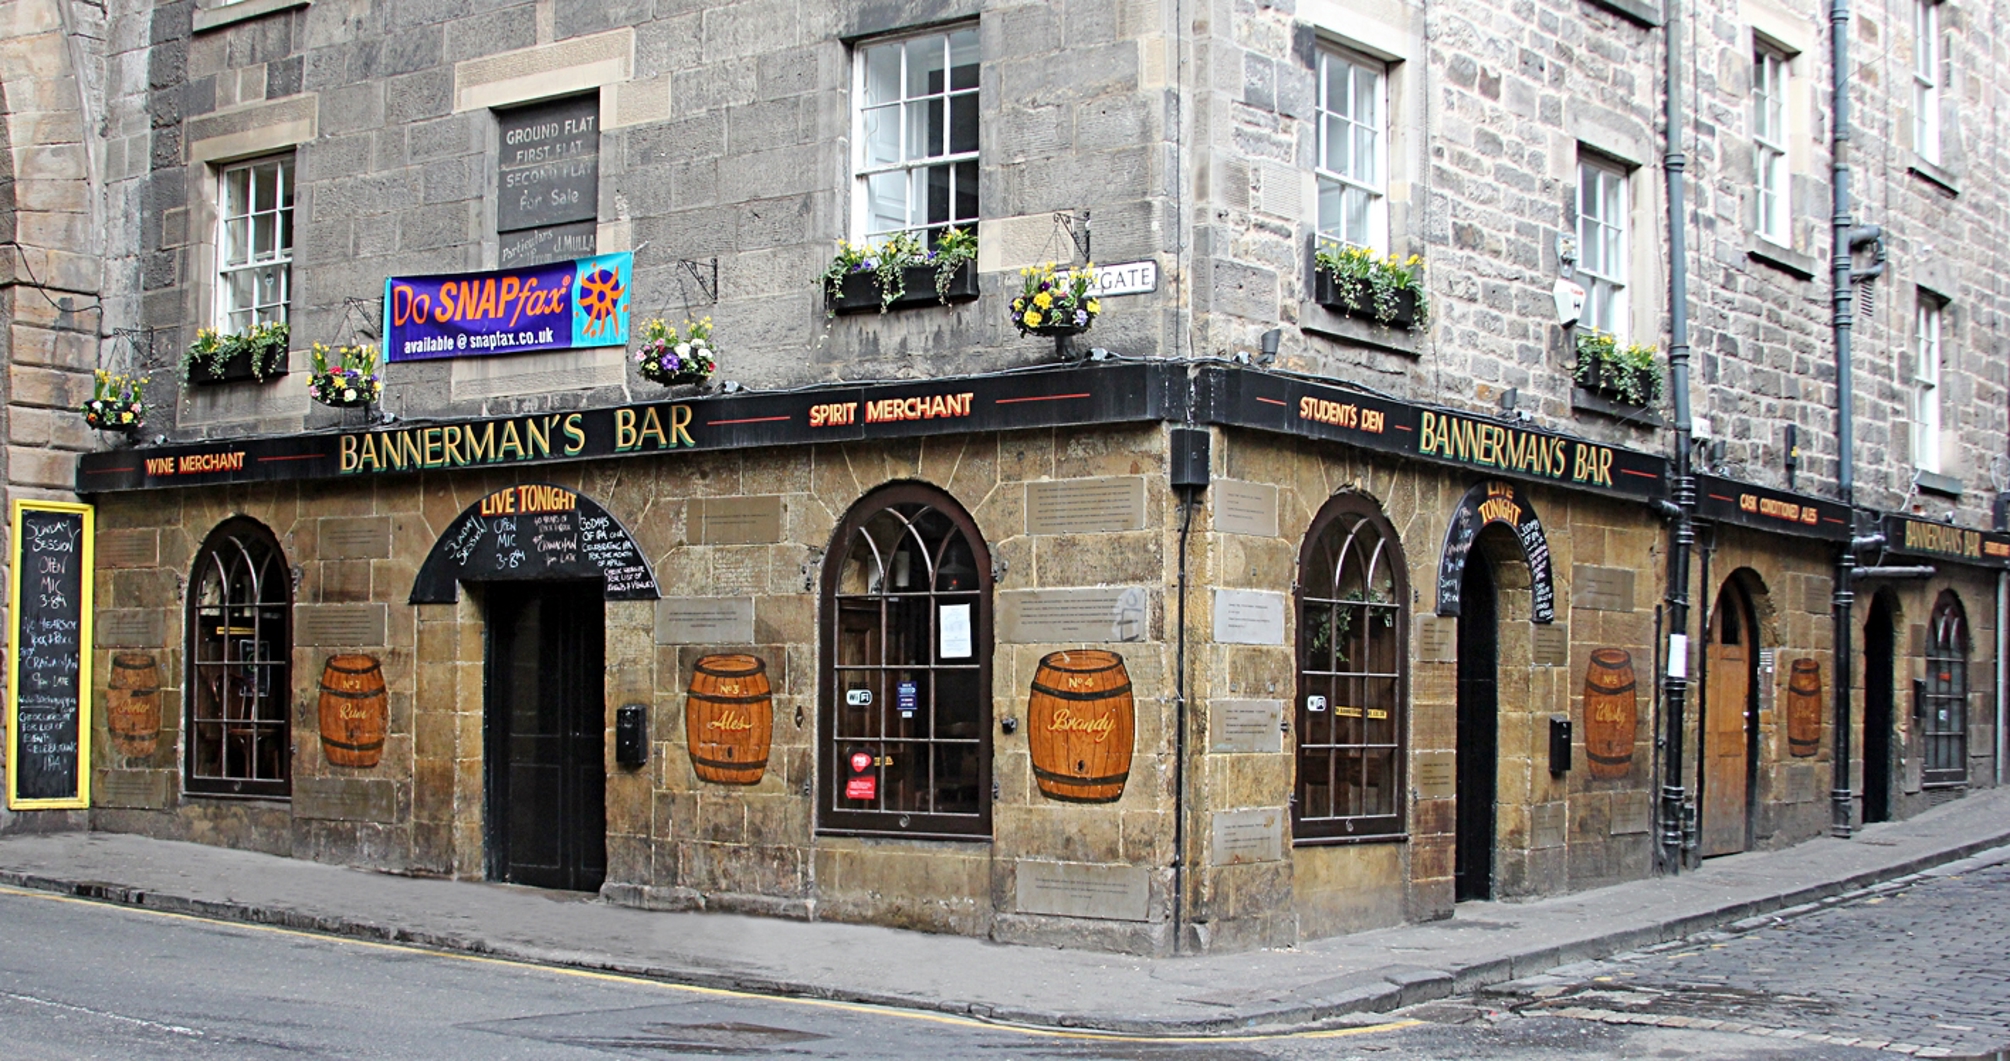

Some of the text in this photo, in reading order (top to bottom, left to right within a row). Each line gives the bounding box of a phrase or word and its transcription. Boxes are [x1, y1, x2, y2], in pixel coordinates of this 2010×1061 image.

[506, 116, 595, 146] GROUND FLAT
[516, 140, 583, 163] FIRST FLAT
[506, 164, 592, 188] SECOND FLAT
[519, 190, 579, 211] For Sale
[502, 230, 553, 262] Particulars
[393, 286, 430, 327] Do
[404, 327, 554, 355] available @ snapfax.co.uk
[809, 392, 974, 427] SPIRIT MERCHANT
[1299, 396, 1385, 433] STUDENT'S DEN
[340, 404, 696, 474] BANNERMAN'S BAR
[1419, 411, 1614, 487] BANNERMAN'S BAR
[146, 452, 246, 475] WINE MERCHANT
[481, 484, 577, 516] LIVE TONIGHT
[1487, 482, 1514, 499] LIVE
[1478, 499, 1522, 527] TONIGHT
[26, 519, 73, 540] SUNDAY
[493, 516, 517, 535] OPEN
[32, 529, 81, 553] SESSION
[496, 533, 516, 549] MIC
[38, 556, 69, 574] OPEN
[40, 576, 64, 596] MIC
[340, 702, 367, 720] Rum
[708, 710, 754, 731] Ales
[1047, 708, 1117, 743] Brandy
